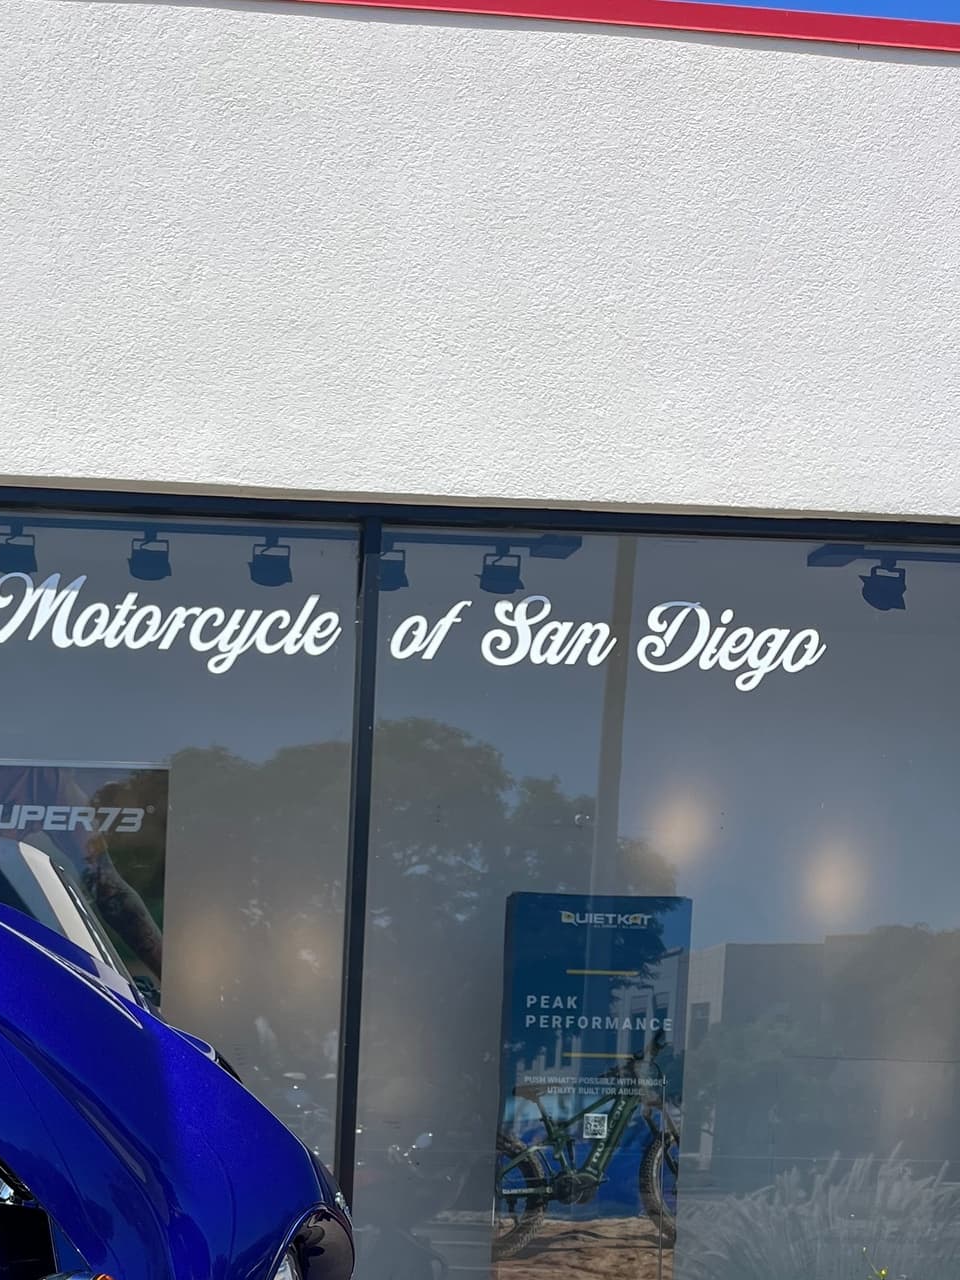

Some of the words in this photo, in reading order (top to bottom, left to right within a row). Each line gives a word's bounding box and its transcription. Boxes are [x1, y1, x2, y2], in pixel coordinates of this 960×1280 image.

[390, 599, 473, 660] of
[481, 595, 617, 666] San
[637, 600, 827, 692] Diego
[559, 910, 652, 928] QUIETKAT
[526, 995, 578, 1009] PEAK
[525, 1015, 673, 1032] PERFORMANCE
[601, 1088, 616, 1096] FOR
